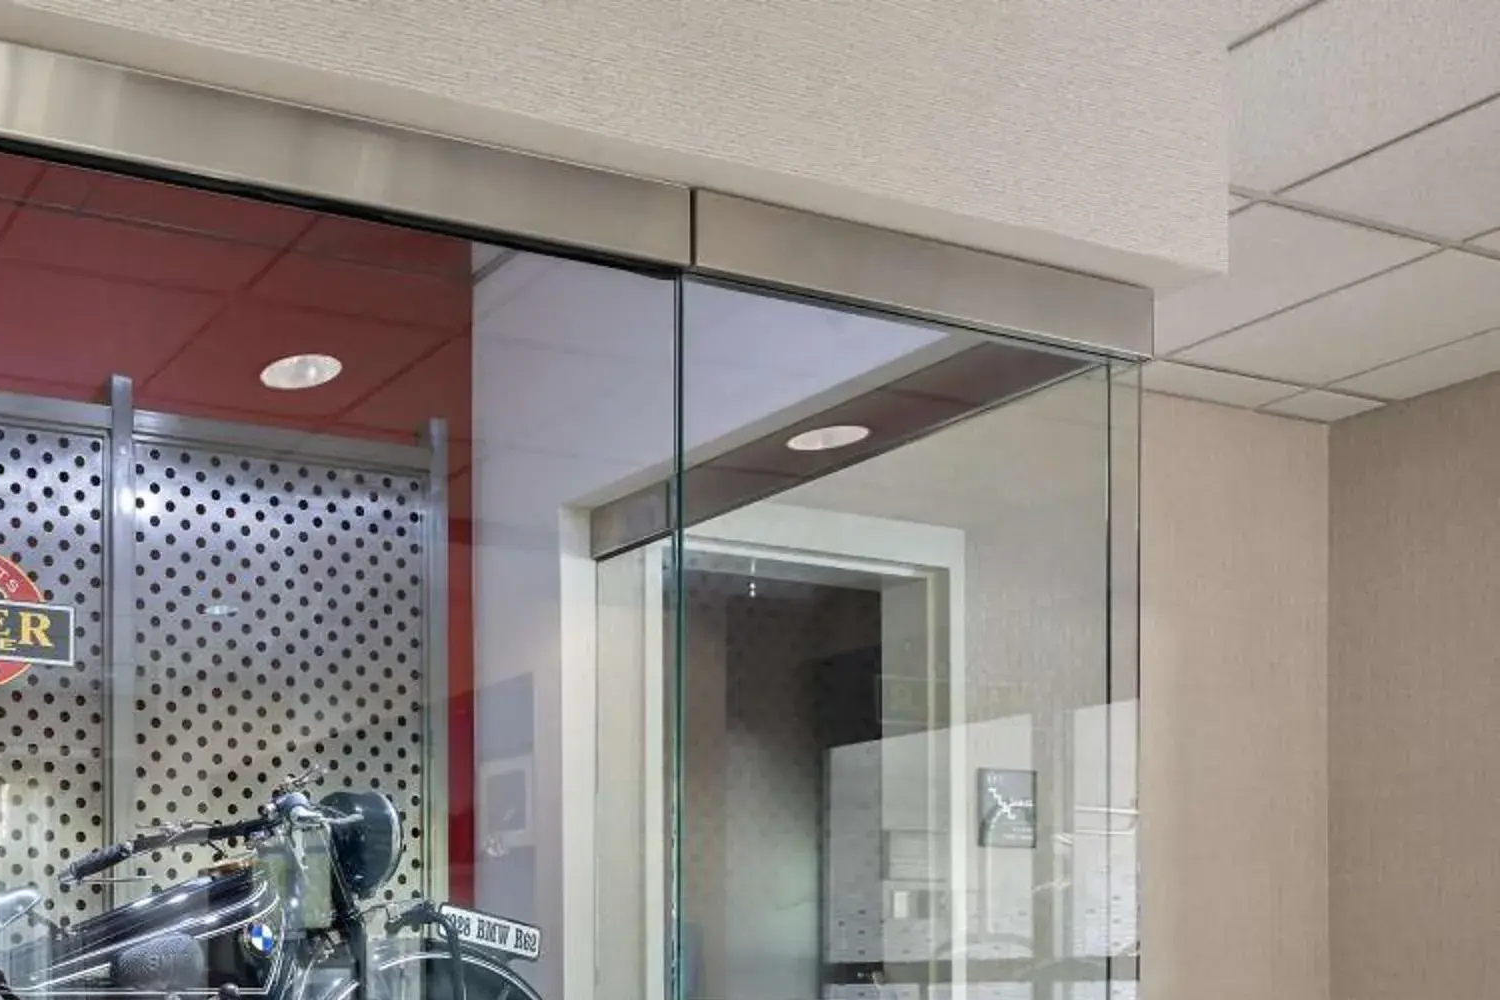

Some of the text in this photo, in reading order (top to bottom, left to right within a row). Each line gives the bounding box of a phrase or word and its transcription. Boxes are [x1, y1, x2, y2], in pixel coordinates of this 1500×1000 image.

[445, 913, 537, 952] 928 BMW R62
